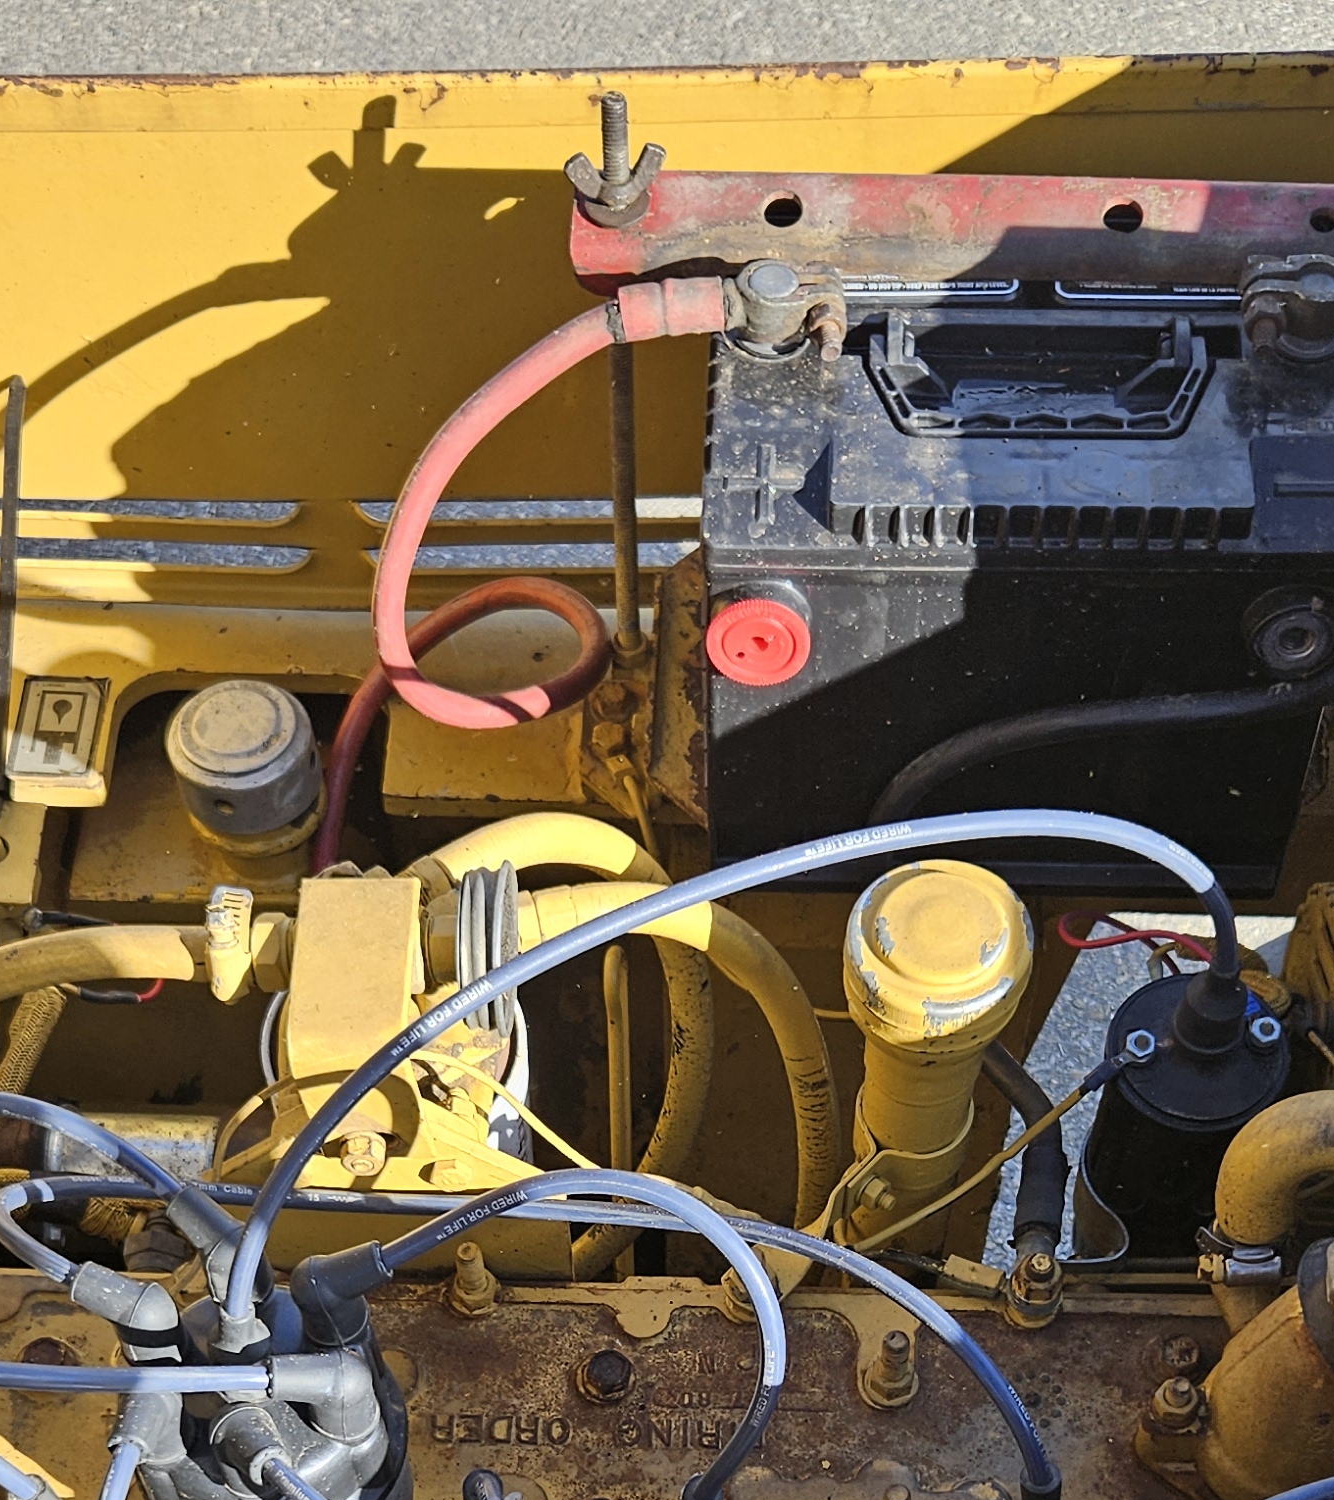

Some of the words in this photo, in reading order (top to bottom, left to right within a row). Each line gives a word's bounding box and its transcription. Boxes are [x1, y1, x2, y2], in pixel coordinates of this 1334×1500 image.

[844, 831, 870, 846] FOR
[872, 824, 912, 839] WIRED
[450, 979, 494, 1011] WIRED
[424, 1005, 453, 1029] FOR
[223, 1185, 254, 1196] Cable
[490, 1189, 529, 1211] WIRED
[466, 1204, 491, 1222] FOR
[428, 1413, 572, 1448] ORDER
